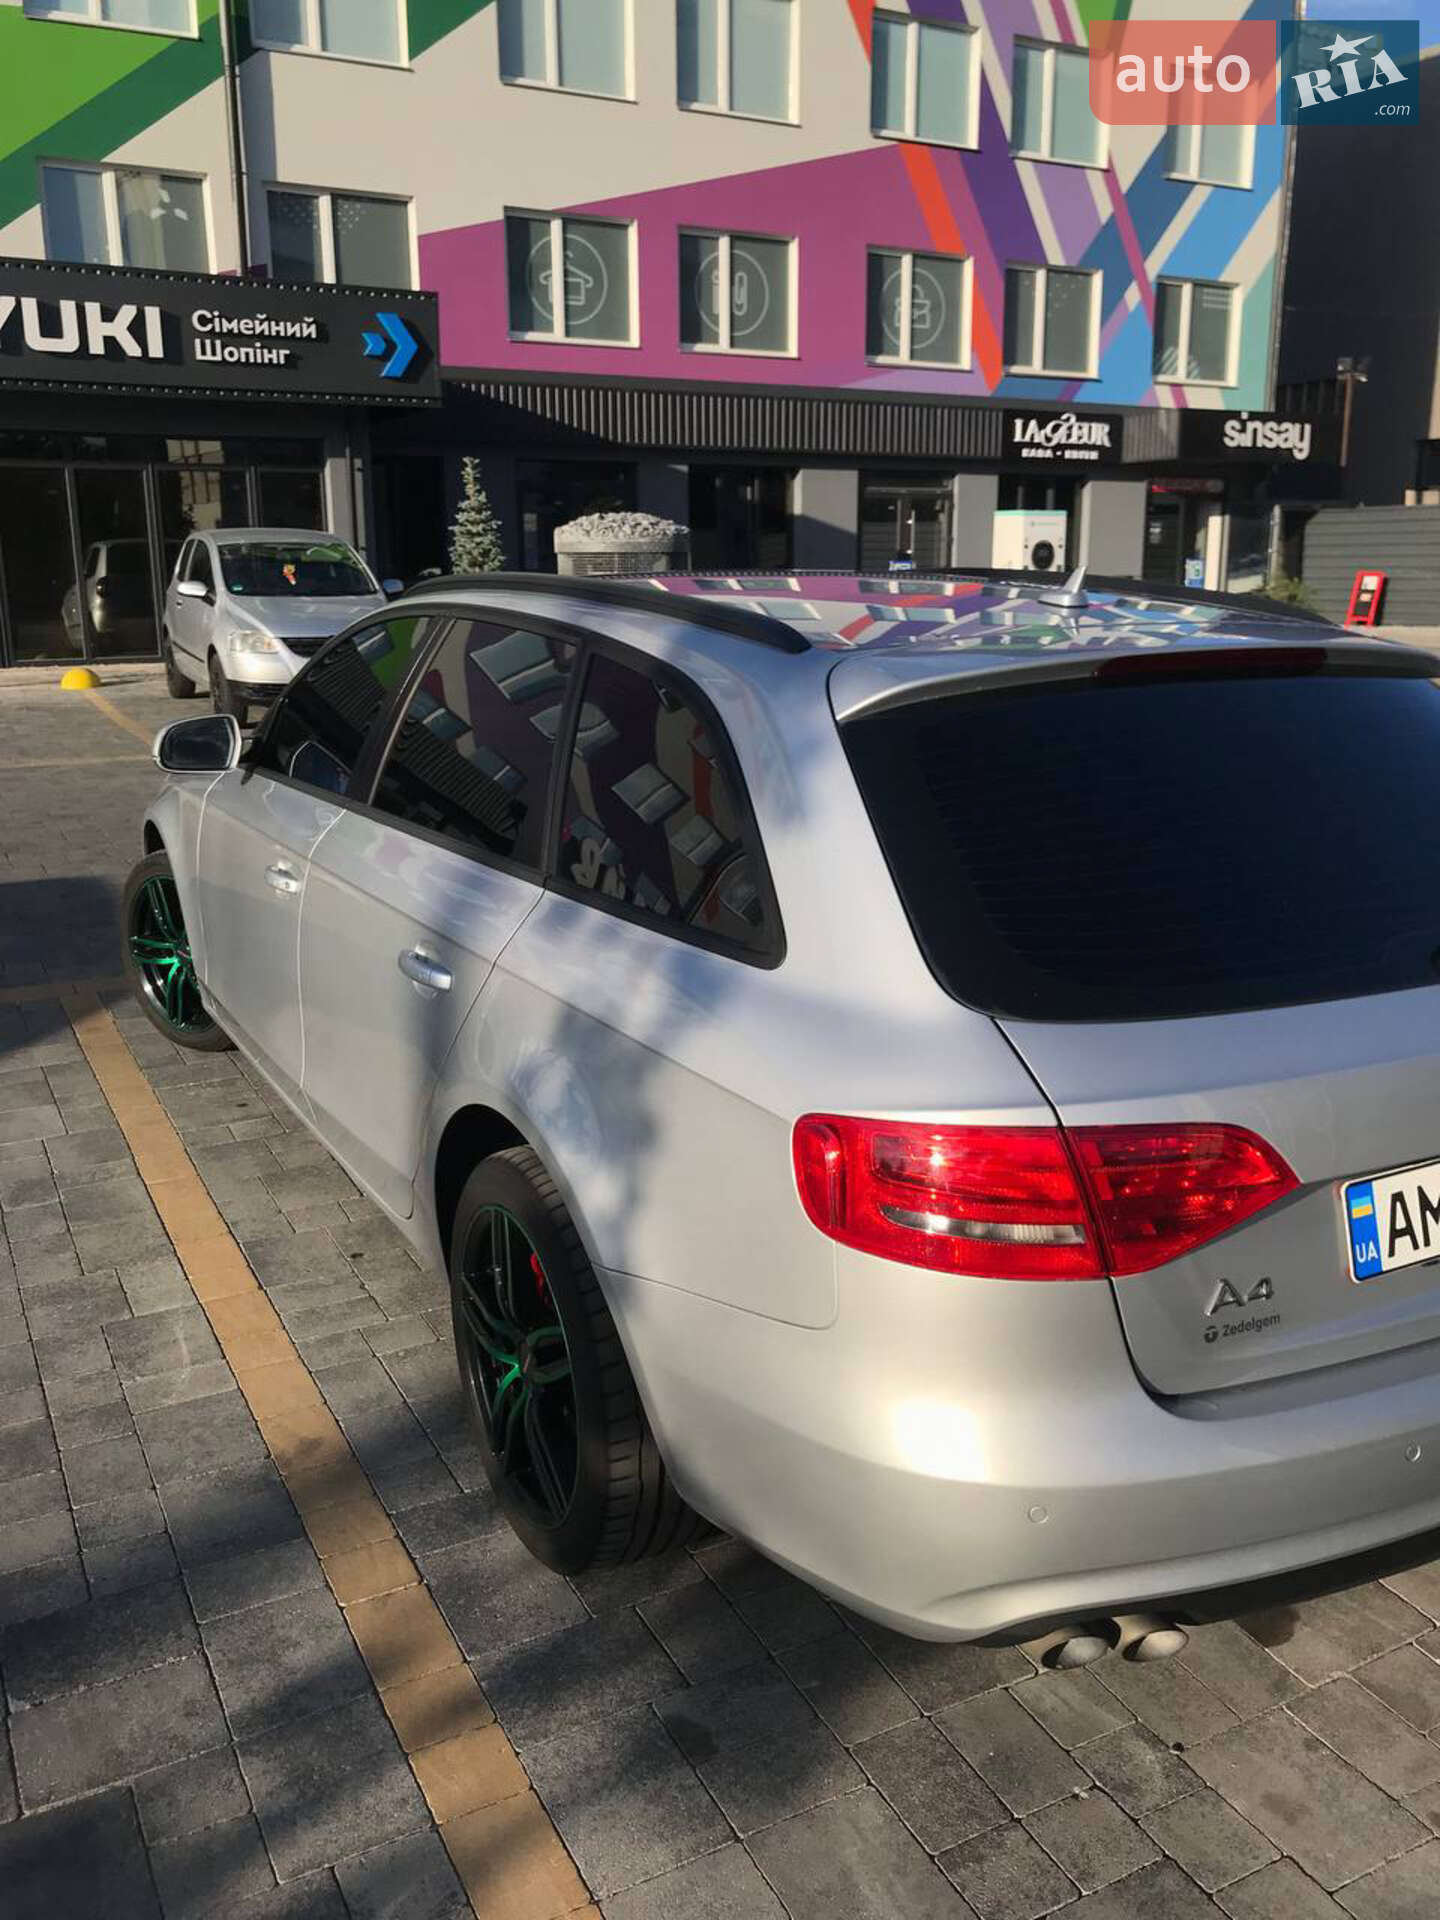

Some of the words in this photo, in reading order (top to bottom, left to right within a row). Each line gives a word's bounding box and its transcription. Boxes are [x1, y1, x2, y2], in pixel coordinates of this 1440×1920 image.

[0, 296, 164, 359] UKI
[191, 309, 318, 339] Сімейний
[194, 338, 291, 365] Шопінг
[1223, 411, 1312, 461] sinsay
[1355, 1240, 1379, 1264] UA
[1203, 1277, 1275, 1317] A4
[1222, 1314, 1281, 1338] Zedelgem
